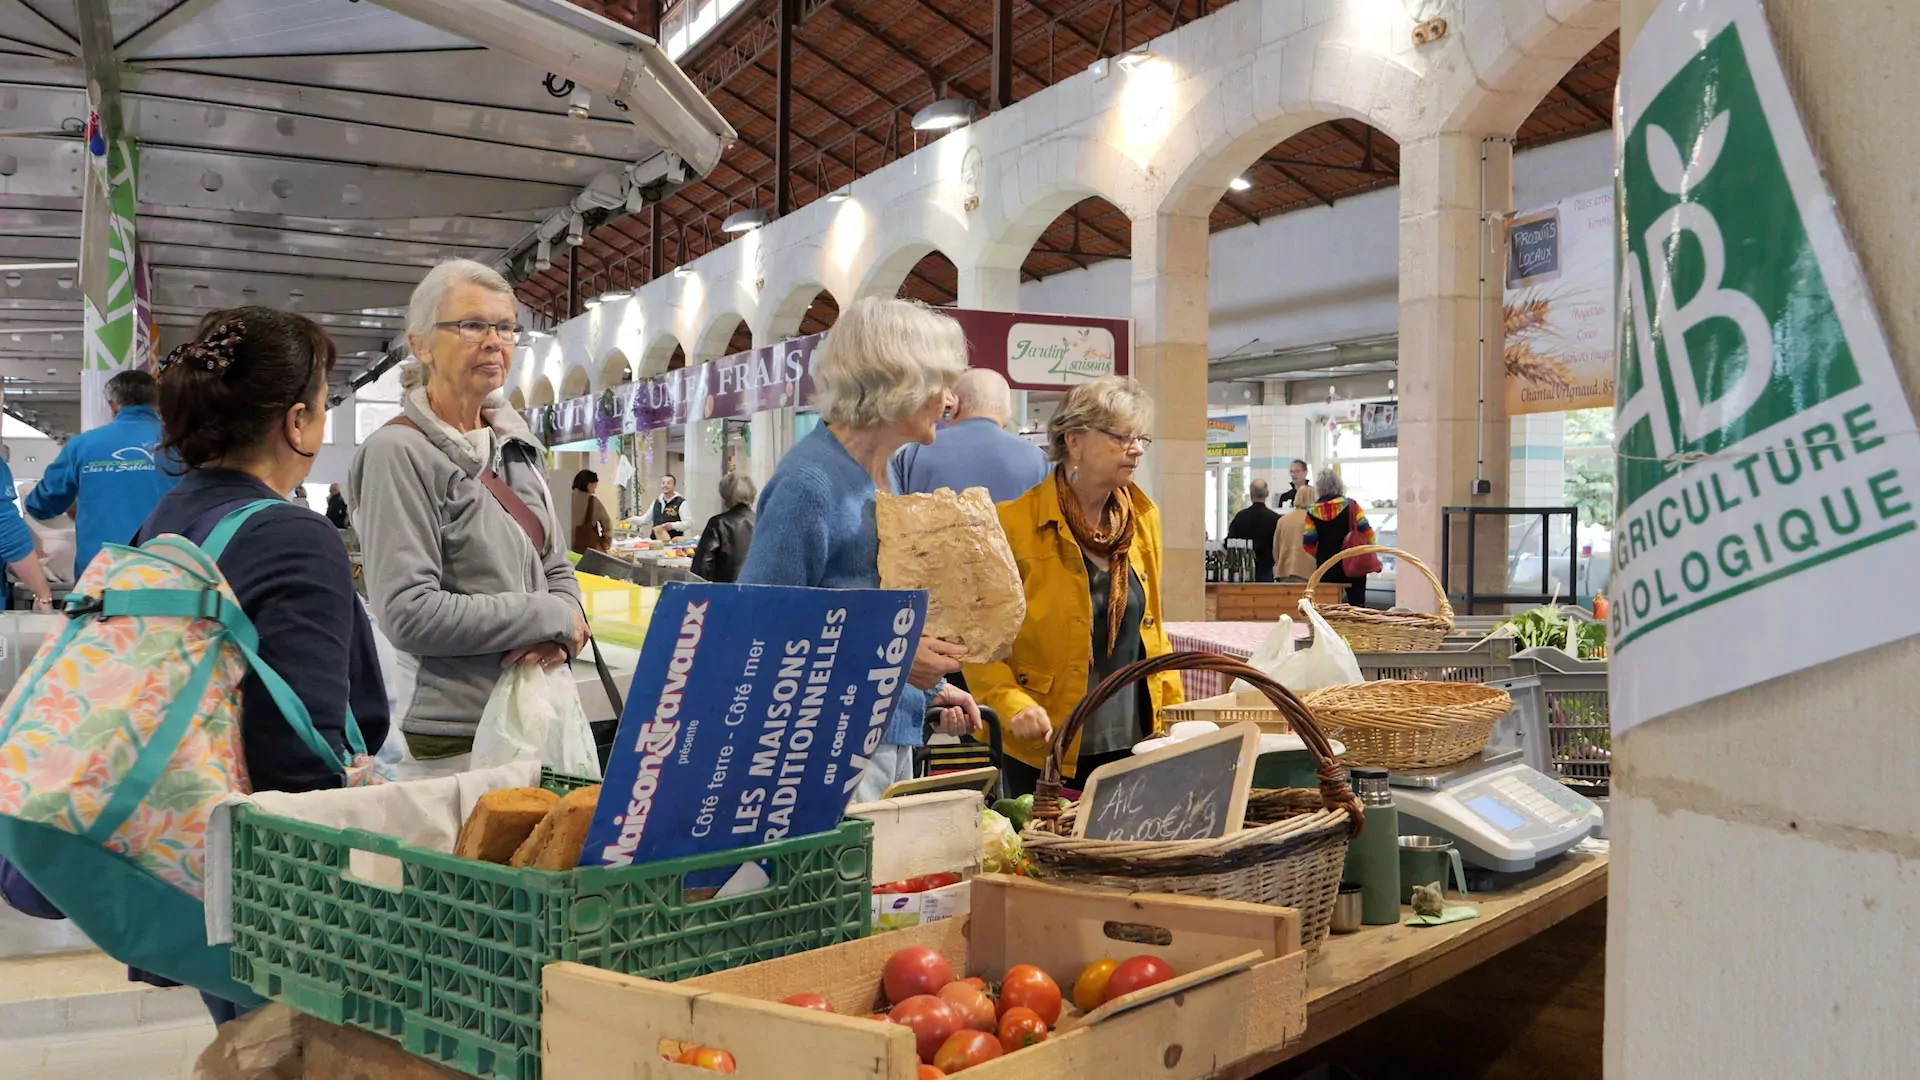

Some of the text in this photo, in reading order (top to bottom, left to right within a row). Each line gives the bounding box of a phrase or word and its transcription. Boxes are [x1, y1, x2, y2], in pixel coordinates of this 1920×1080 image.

[1514, 222, 1556, 248] PRODUITS
[1518, 247, 1552, 268] LOCAUX
[716, 350, 804, 396] FRAIS
[1011, 340, 1064, 360] Jardin
[1068, 358, 1112, 372] saisons
[1520, 381, 1555, 402] Chantal
[1612, 403, 1886, 578] GRICULTURE
[1612, 468, 1912, 638] BIOLOGIQUE
[678, 719, 699, 765] présente
[691, 793, 718, 838] Côté
[707, 745, 733, 790] terre
[725, 684, 752, 726] Côté
[744, 638, 766, 677] mer
[732, 639, 811, 834] LES MAISONS
[761, 607, 847, 864] RADITIONNELLES
[824, 764, 837, 785] au
[840, 685, 857, 706] de
[843, 606, 915, 794] Vendée
